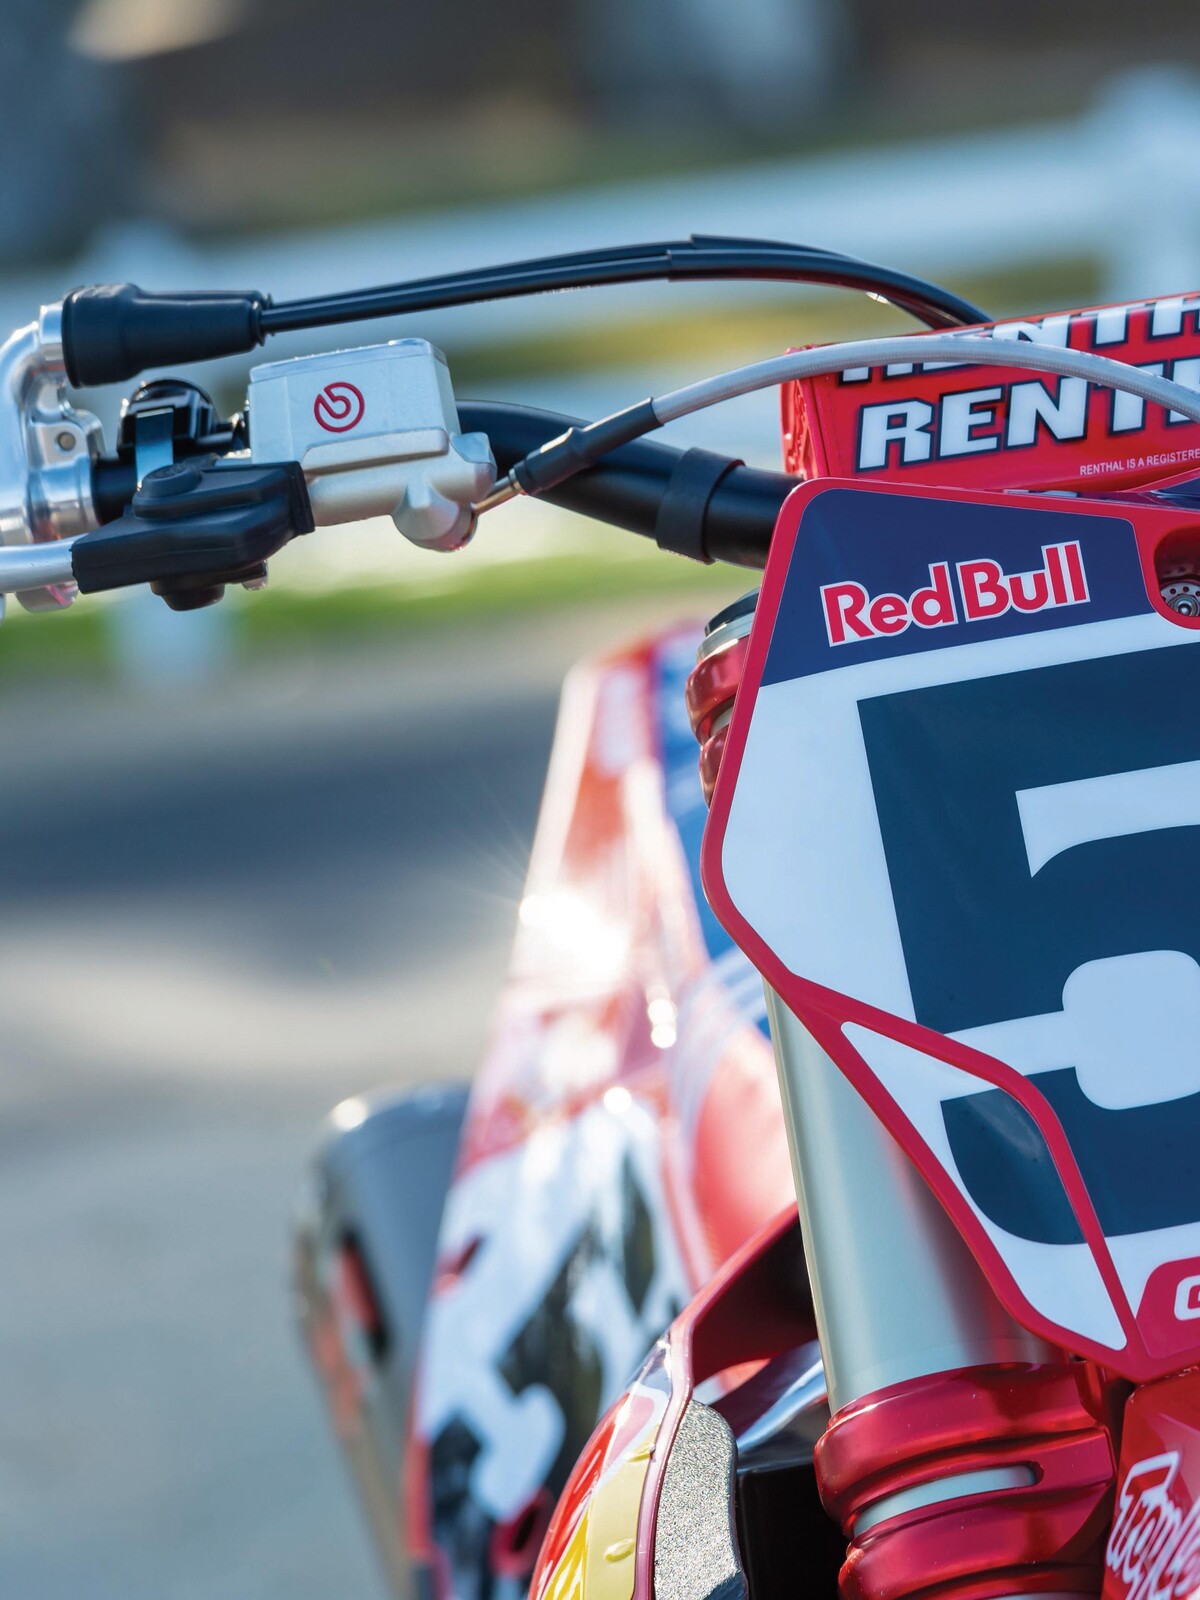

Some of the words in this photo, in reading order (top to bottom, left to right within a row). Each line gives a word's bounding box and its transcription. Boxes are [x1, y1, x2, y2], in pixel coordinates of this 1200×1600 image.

[1079, 461, 1125, 476] RENTHAL
[1126, 459, 1137, 470] IS
[1137, 457, 1146, 468] A
[820, 561, 958, 647] Red
[956, 540, 1090, 622] Bull
